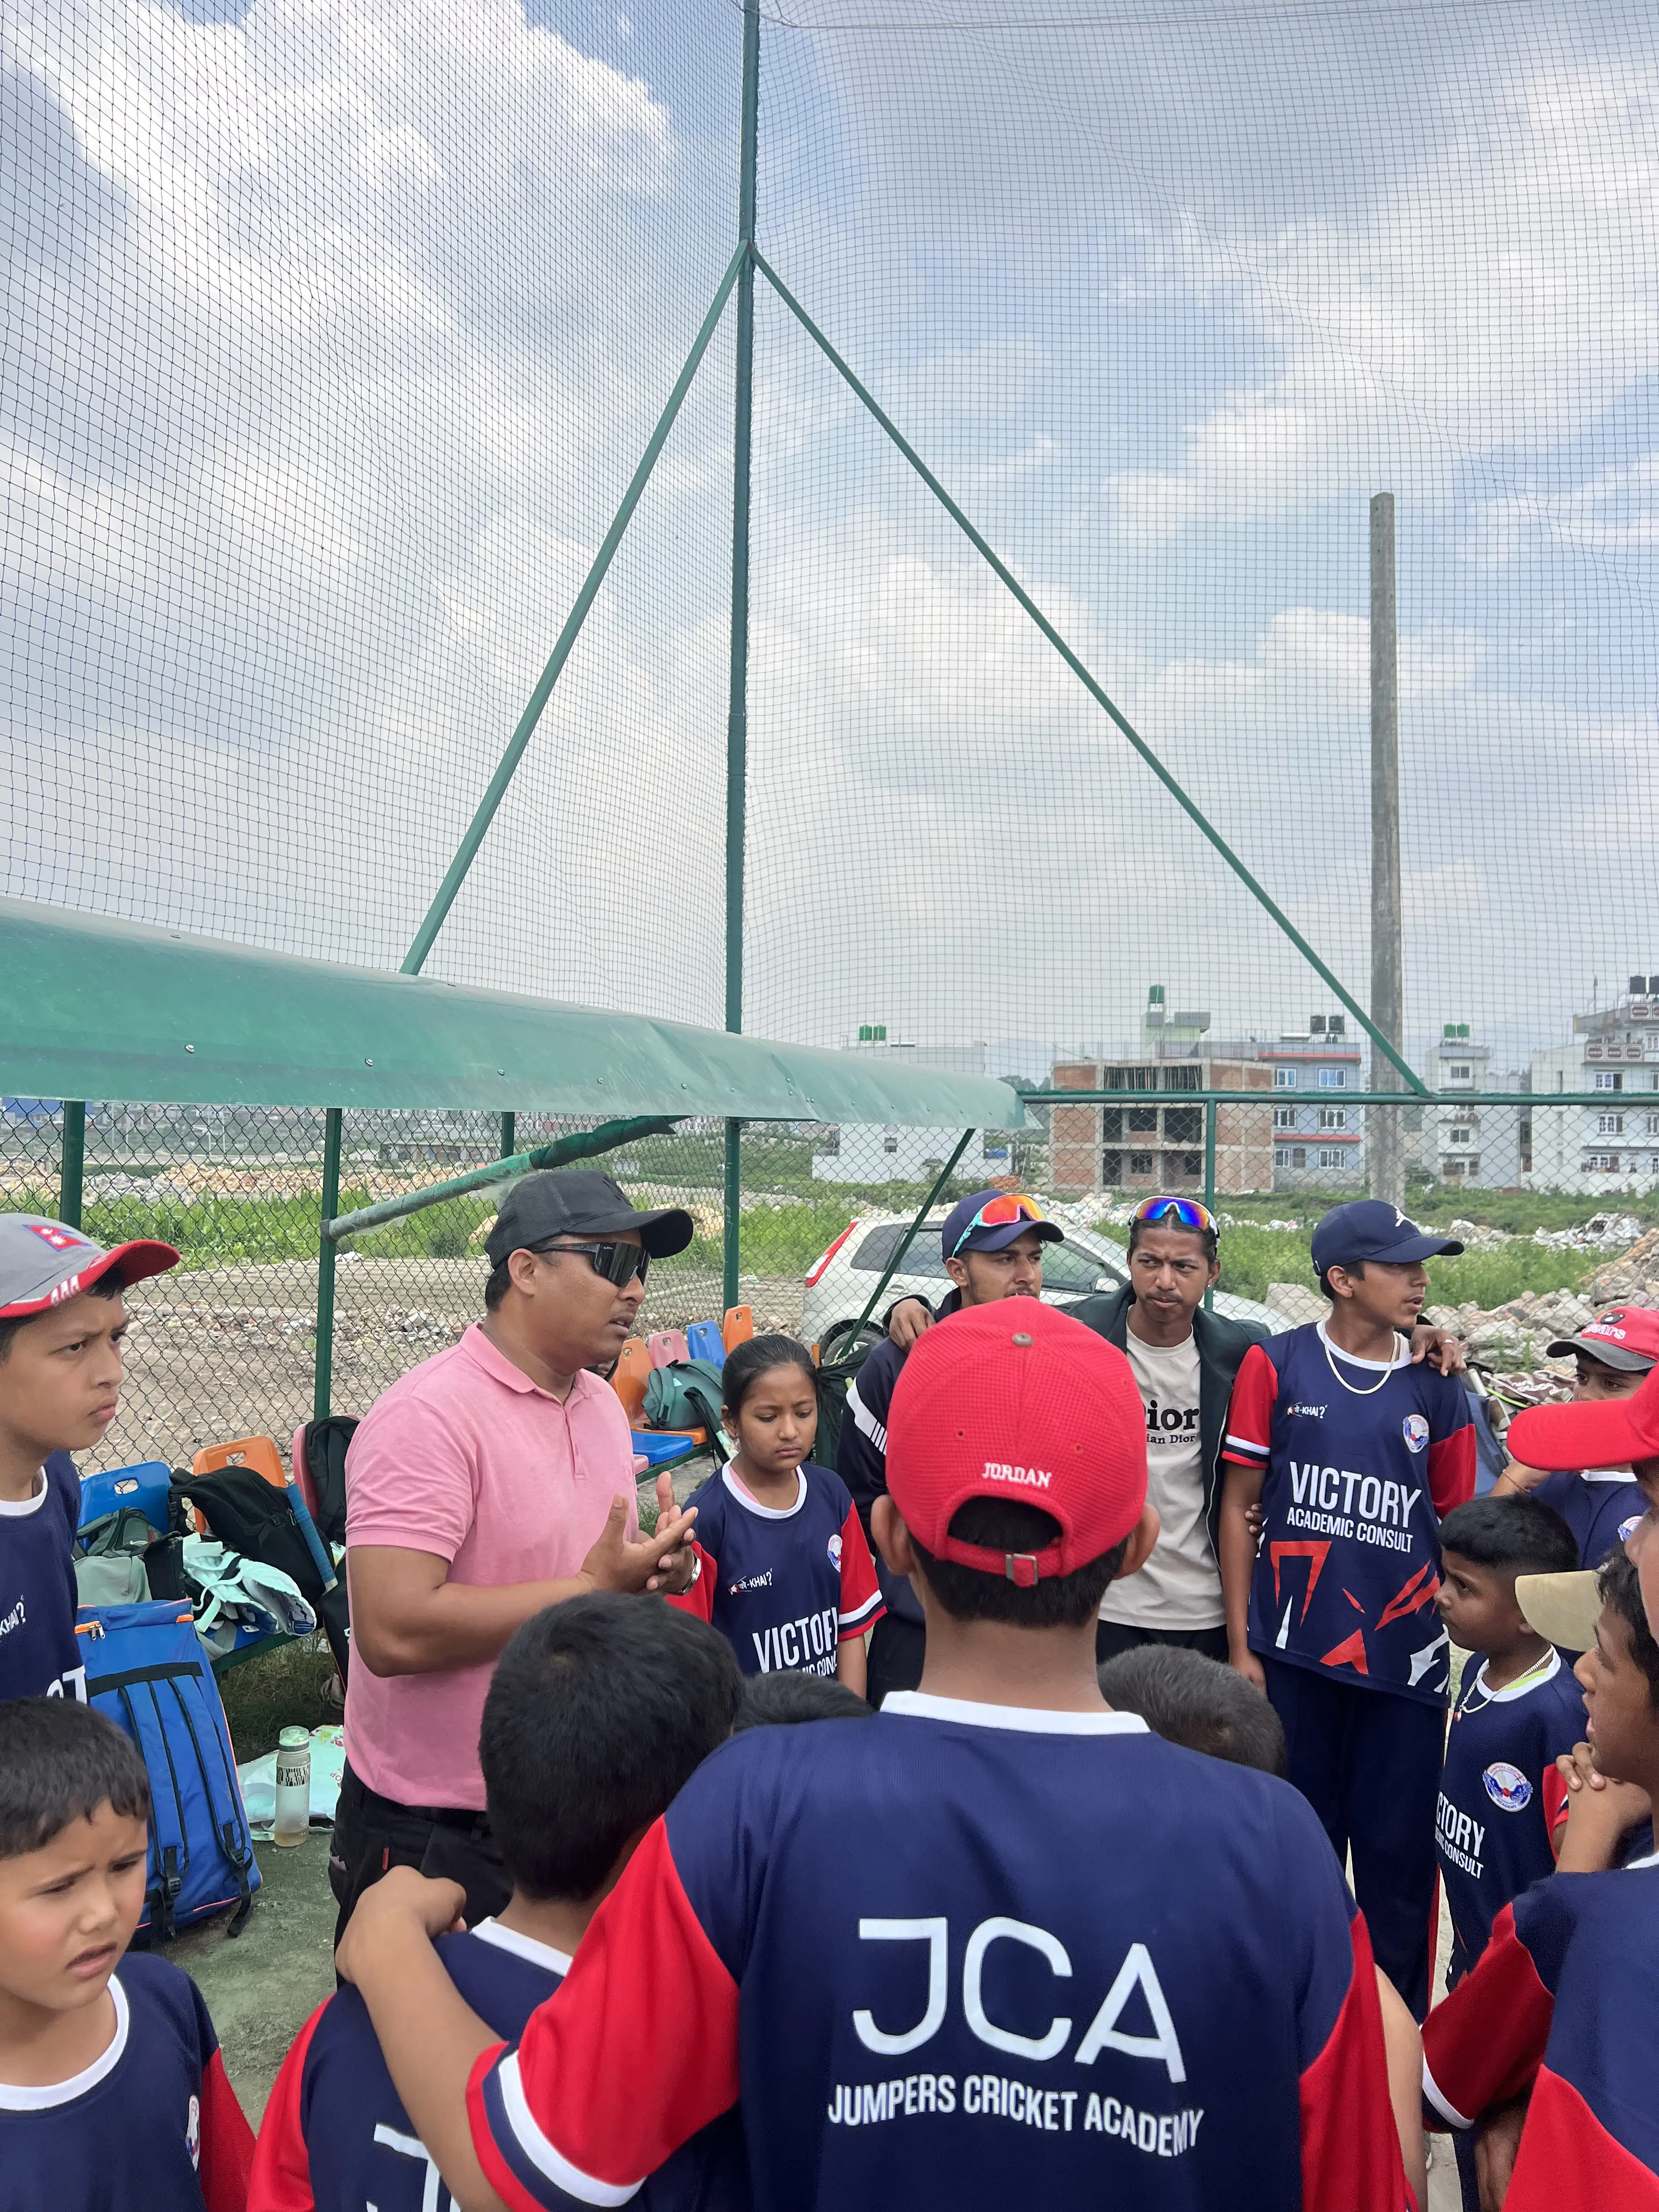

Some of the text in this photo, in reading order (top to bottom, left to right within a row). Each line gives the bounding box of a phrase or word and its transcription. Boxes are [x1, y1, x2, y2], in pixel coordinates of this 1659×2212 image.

[1143, 1400, 1200, 1431] ior
[1170, 1434, 1195, 1443] Dior
[981, 1462, 1052, 1488] JORDAN
[1290, 1461, 1422, 1528] VICTORY
[1286, 1507, 1414, 1553] ACADEMIC CONSULT
[1436, 1791, 1485, 1858] CTORY
[1444, 1839, 1484, 1879] CONSULT
[853, 1916, 1187, 2084] JCA
[828, 2074, 1204, 2158] JUMPERS CRICKET ACADEMY
